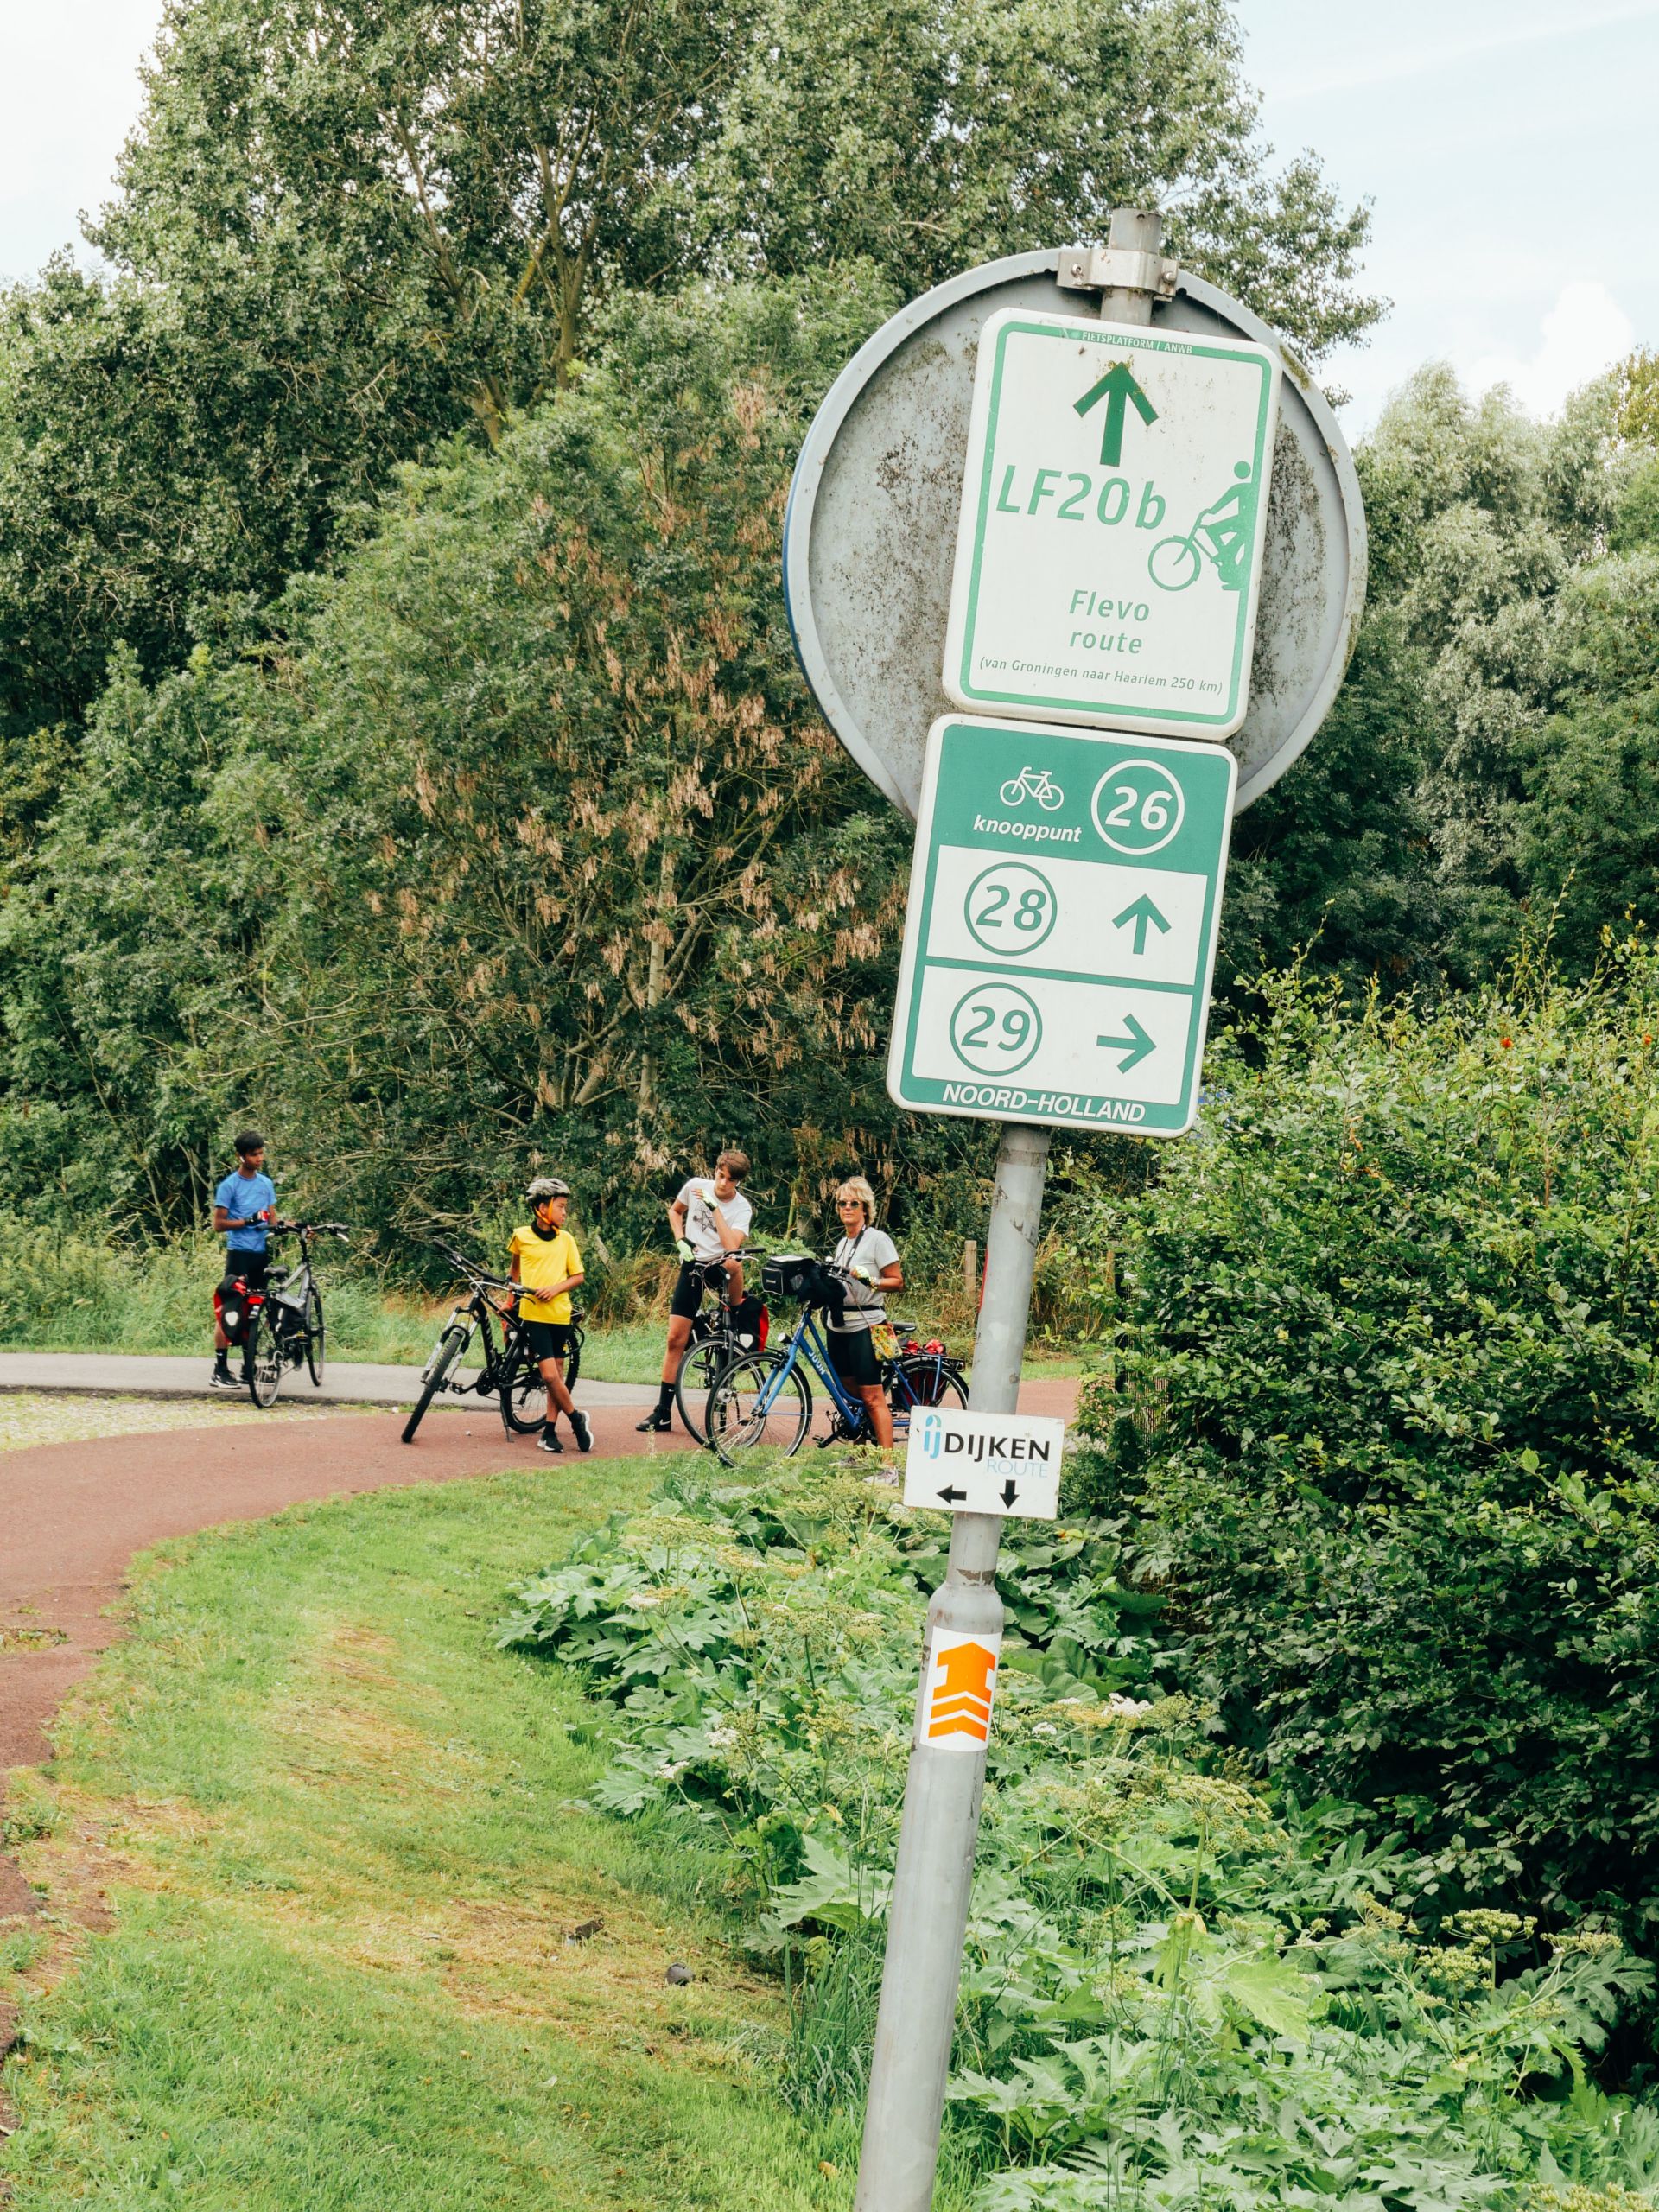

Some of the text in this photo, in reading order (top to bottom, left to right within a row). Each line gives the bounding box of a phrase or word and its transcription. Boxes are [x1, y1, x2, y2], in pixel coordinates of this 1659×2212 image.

[1082, 331, 1154, 349] FIETSPLATFORM
[1164, 343, 1193, 354] ANWB
[995, 464, 1167, 531] LF20b
[1069, 588, 1150, 622] Flevo
[1069, 629, 1143, 654] route
[979, 656, 1223, 695] (van Groningen naar Haarlem 250 km)
[973, 814, 1083, 842] knooppunt
[1105, 786, 1173, 831] 26
[976, 884, 1046, 931] 28
[961, 1005, 1031, 1052] 29
[942, 1083, 1146, 1122] NOORD-HOLLAND
[987, 1459, 1048, 1478] ROUTE
